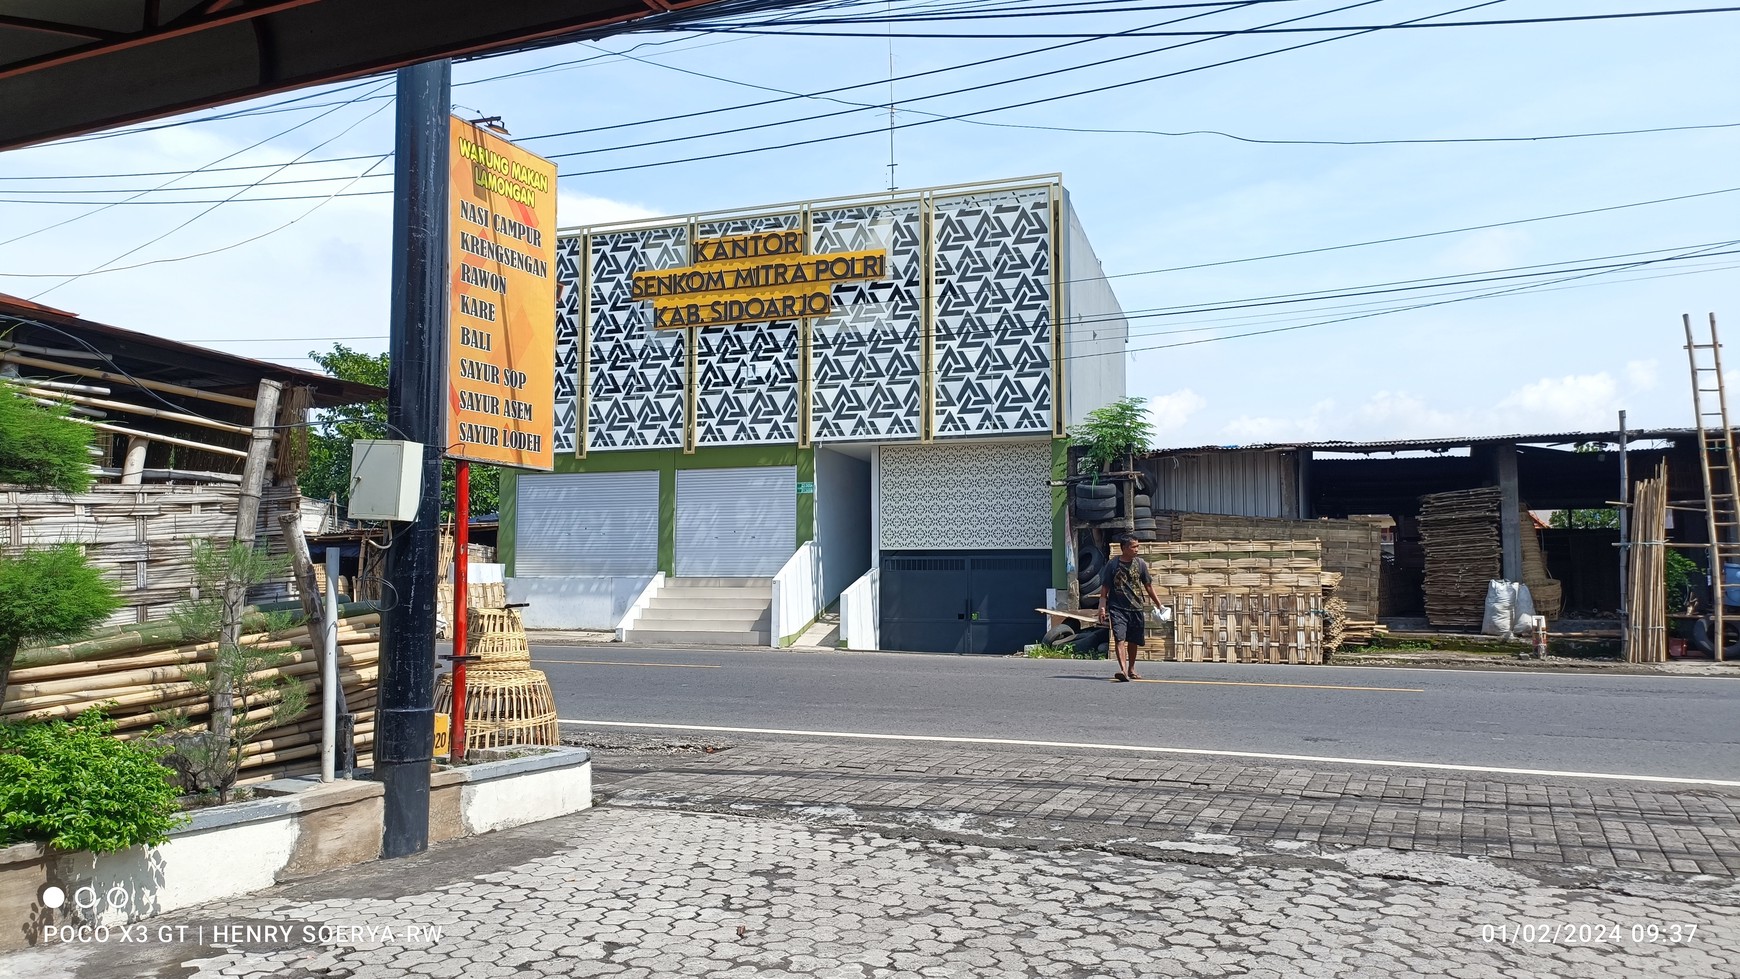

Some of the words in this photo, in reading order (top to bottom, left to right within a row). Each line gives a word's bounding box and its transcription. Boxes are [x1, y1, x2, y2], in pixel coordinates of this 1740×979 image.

[459, 136, 509, 176] WARUNG
[511, 161, 549, 194] MAKAN
[474, 165, 535, 209] LAMONGAN
[460, 199, 489, 228] NASI
[493, 213, 542, 249] CAMPUR
[460, 230, 547, 280] KRENGSENGAN
[694, 232, 801, 263] KANTOR
[460, 263, 507, 295] RAWON
[633, 271, 725, 298] SENKOM
[733, 262, 808, 289] MITRA
[815, 255, 884, 281] POLRI
[460, 295, 495, 322] KARE
[654, 302, 704, 327] KAB.
[711, 292, 830, 322] SIDOARJO
[460, 326, 492, 352] BALI
[459, 358, 500, 385] SAYUR
[503, 368, 527, 390] SOP
[459, 390, 500, 416] SAYUR
[503, 399, 533, 421] ASEM
[459, 422, 500, 447] SAYUR
[502, 428, 541, 453] LODEH
